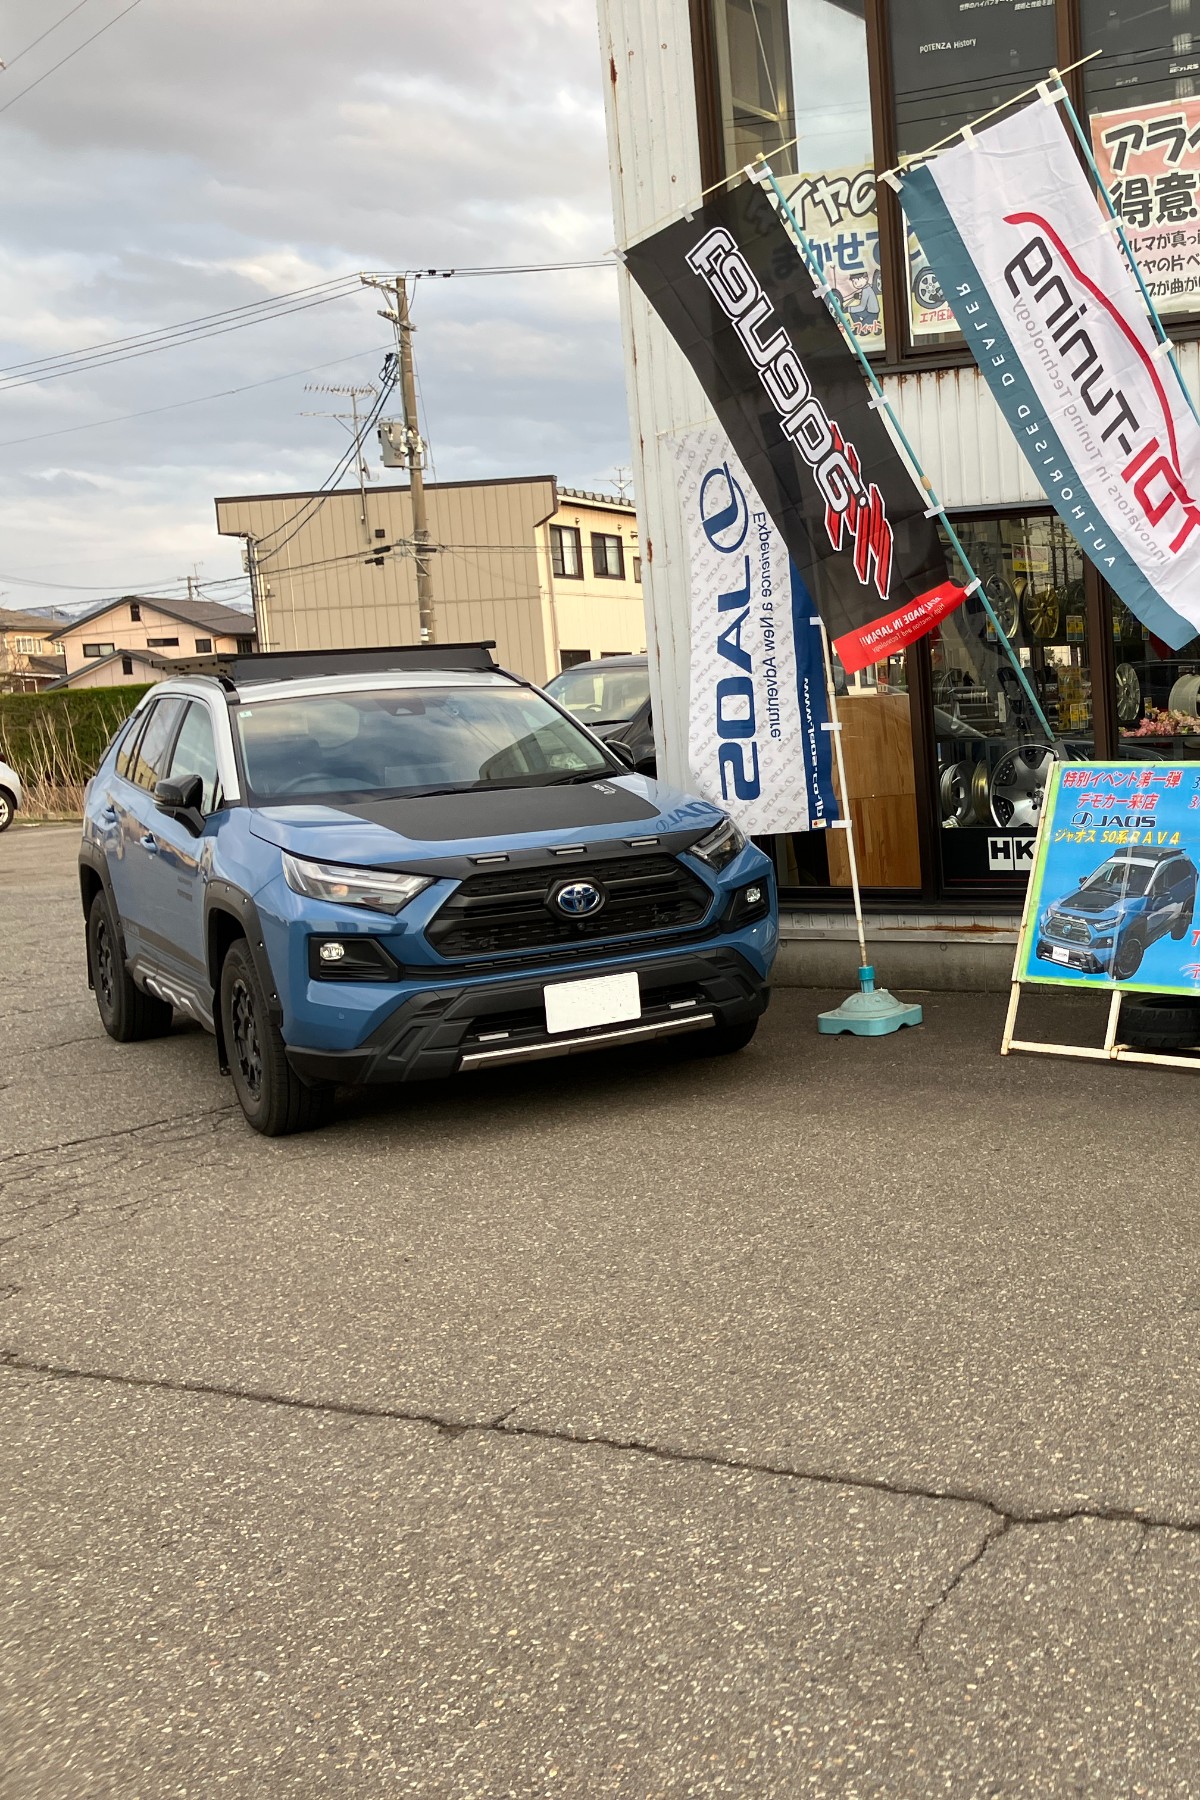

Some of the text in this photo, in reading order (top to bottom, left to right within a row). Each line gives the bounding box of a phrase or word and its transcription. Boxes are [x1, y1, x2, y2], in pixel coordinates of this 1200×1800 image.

[919, 38, 977, 54] POTENZA History
[1063, 771, 1183, 788] 特別イベント第一弾
[1077, 793, 1159, 810] デモカー来店
[1093, 815, 1156, 828] JAOS
[1054, 829, 1096, 843] ジャオス
